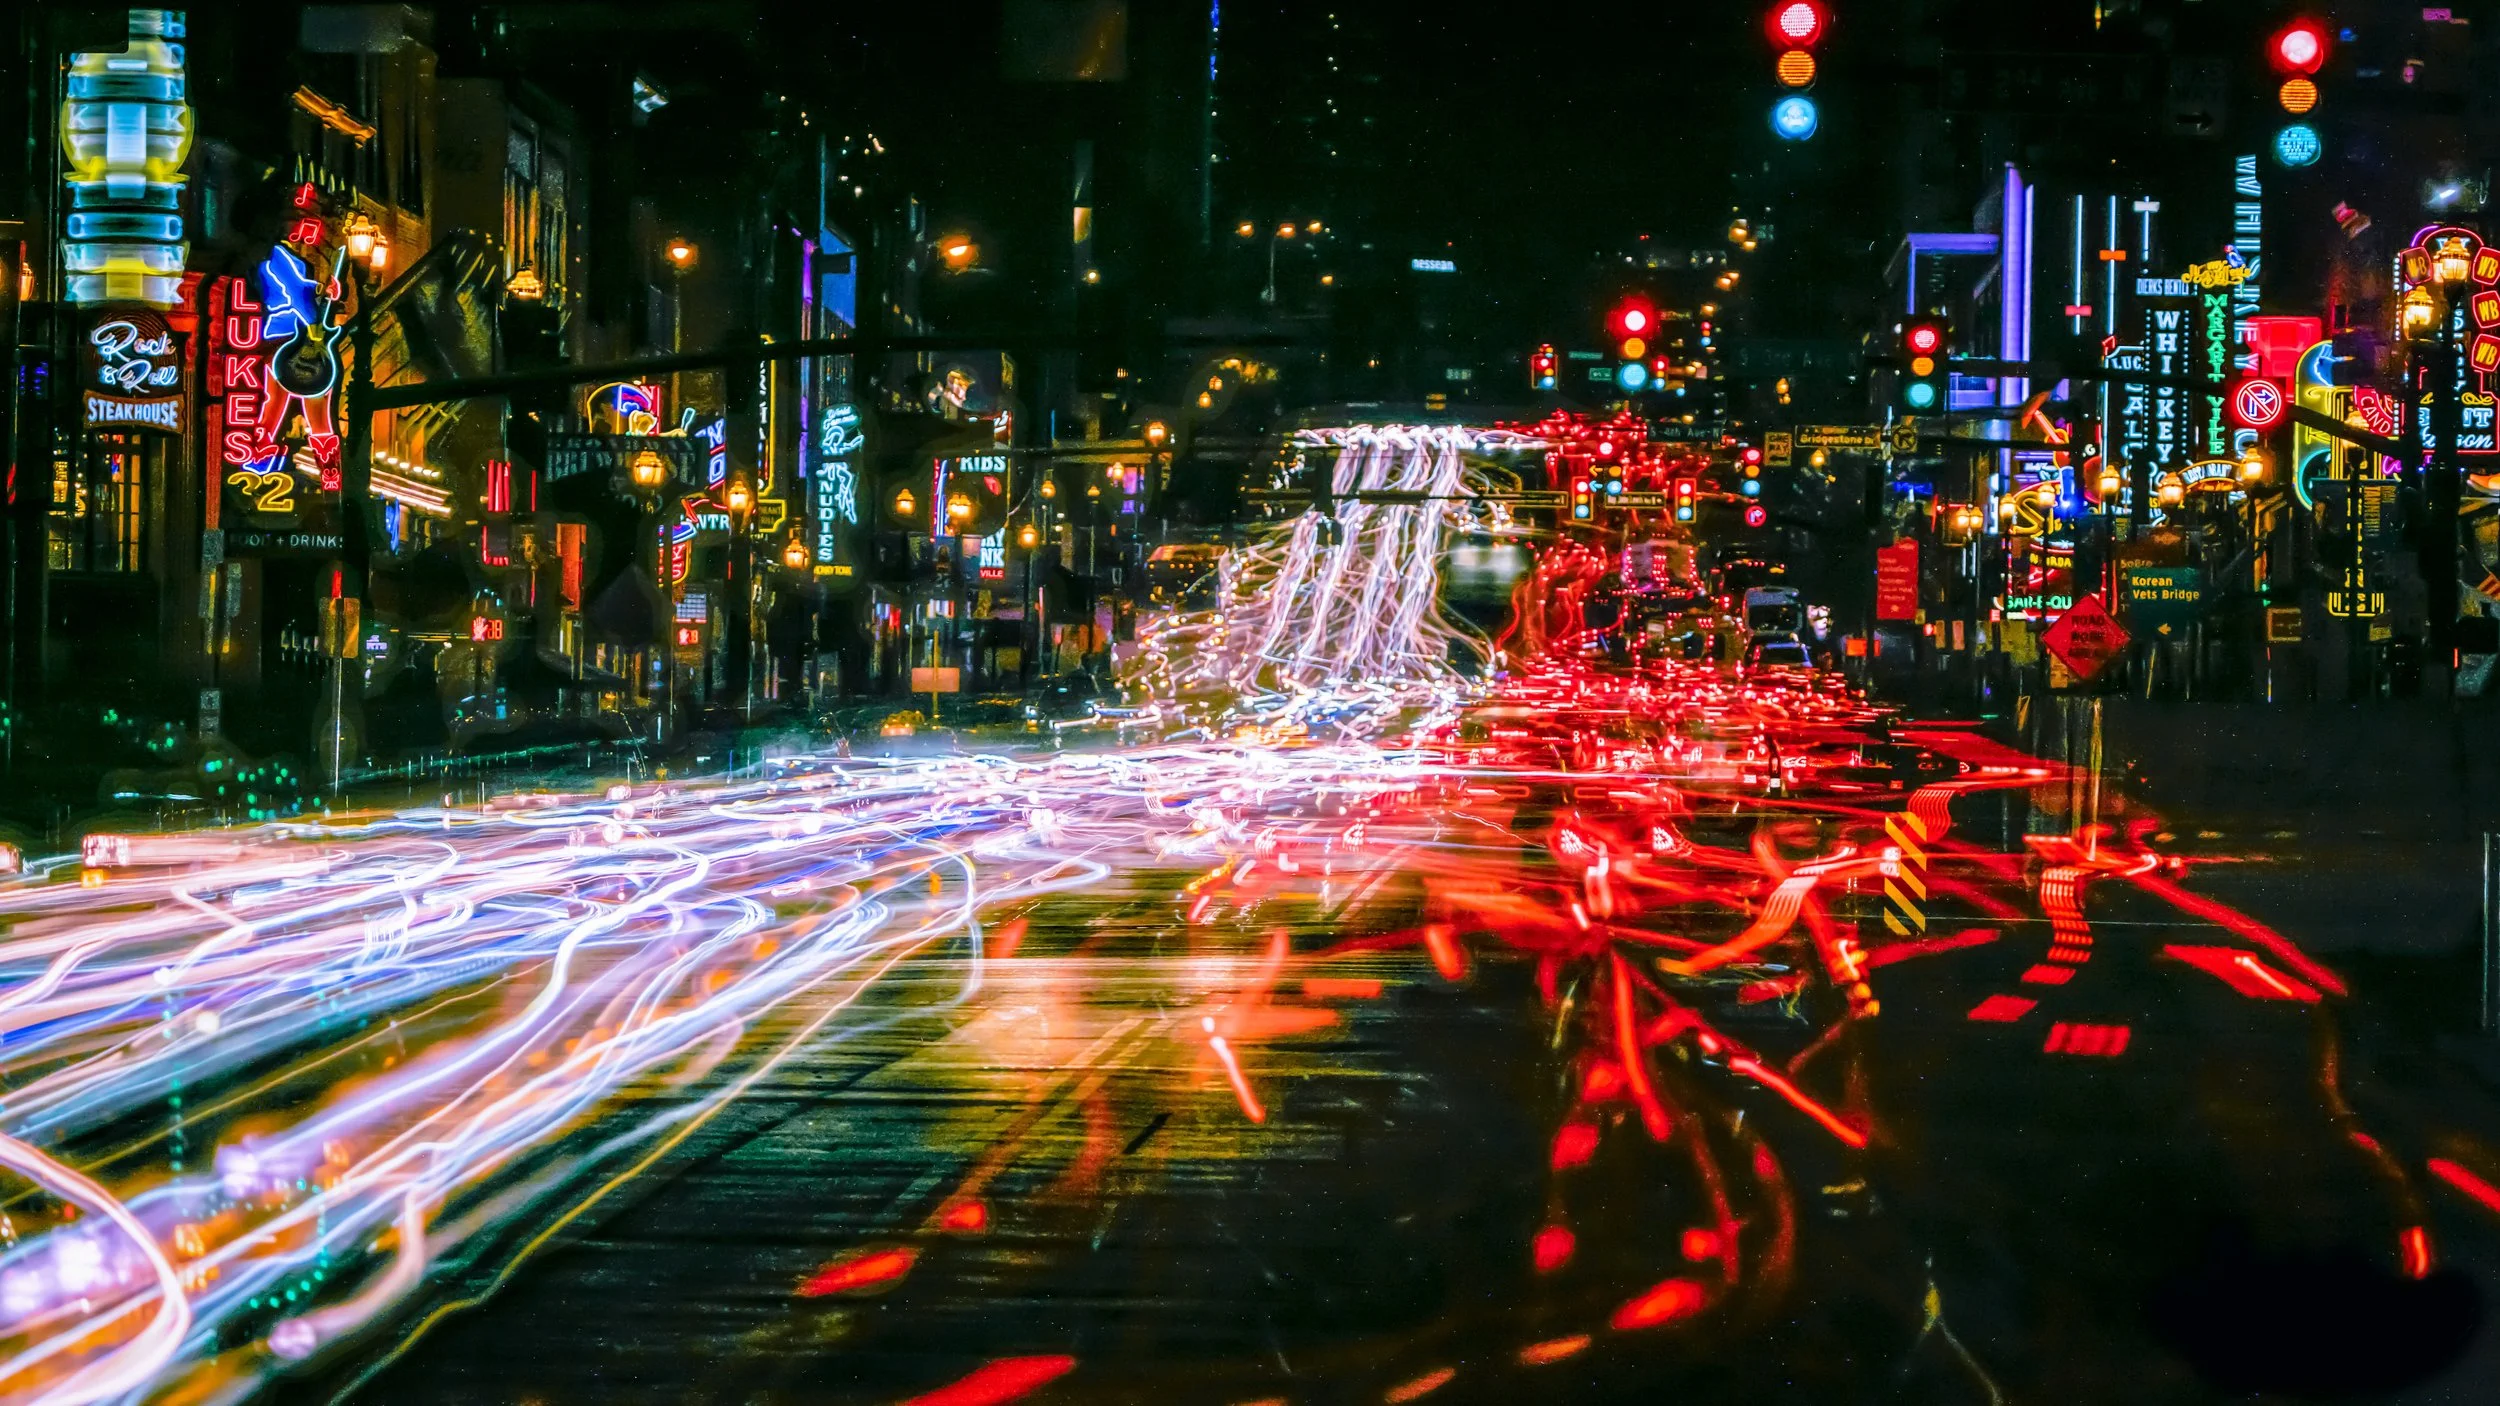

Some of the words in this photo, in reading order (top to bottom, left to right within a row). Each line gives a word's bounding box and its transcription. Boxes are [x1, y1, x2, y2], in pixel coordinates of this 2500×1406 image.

[2477, 254, 2499, 277] WB
[2478, 299, 2500, 322] WB
[90, 320, 177, 362] Rock
[2475, 344, 2498, 366] WB
[87, 397, 178, 427] STEAKHOUSE
[2360, 396, 2392, 434] CAND
[1800, 434, 1863, 446] Bridgestone
[817, 480, 835, 562] NUDIES
[2131, 575, 2173, 587] Korean
[2132, 589, 2158, 600] Vets
[2162, 589, 2201, 602] Bridge
